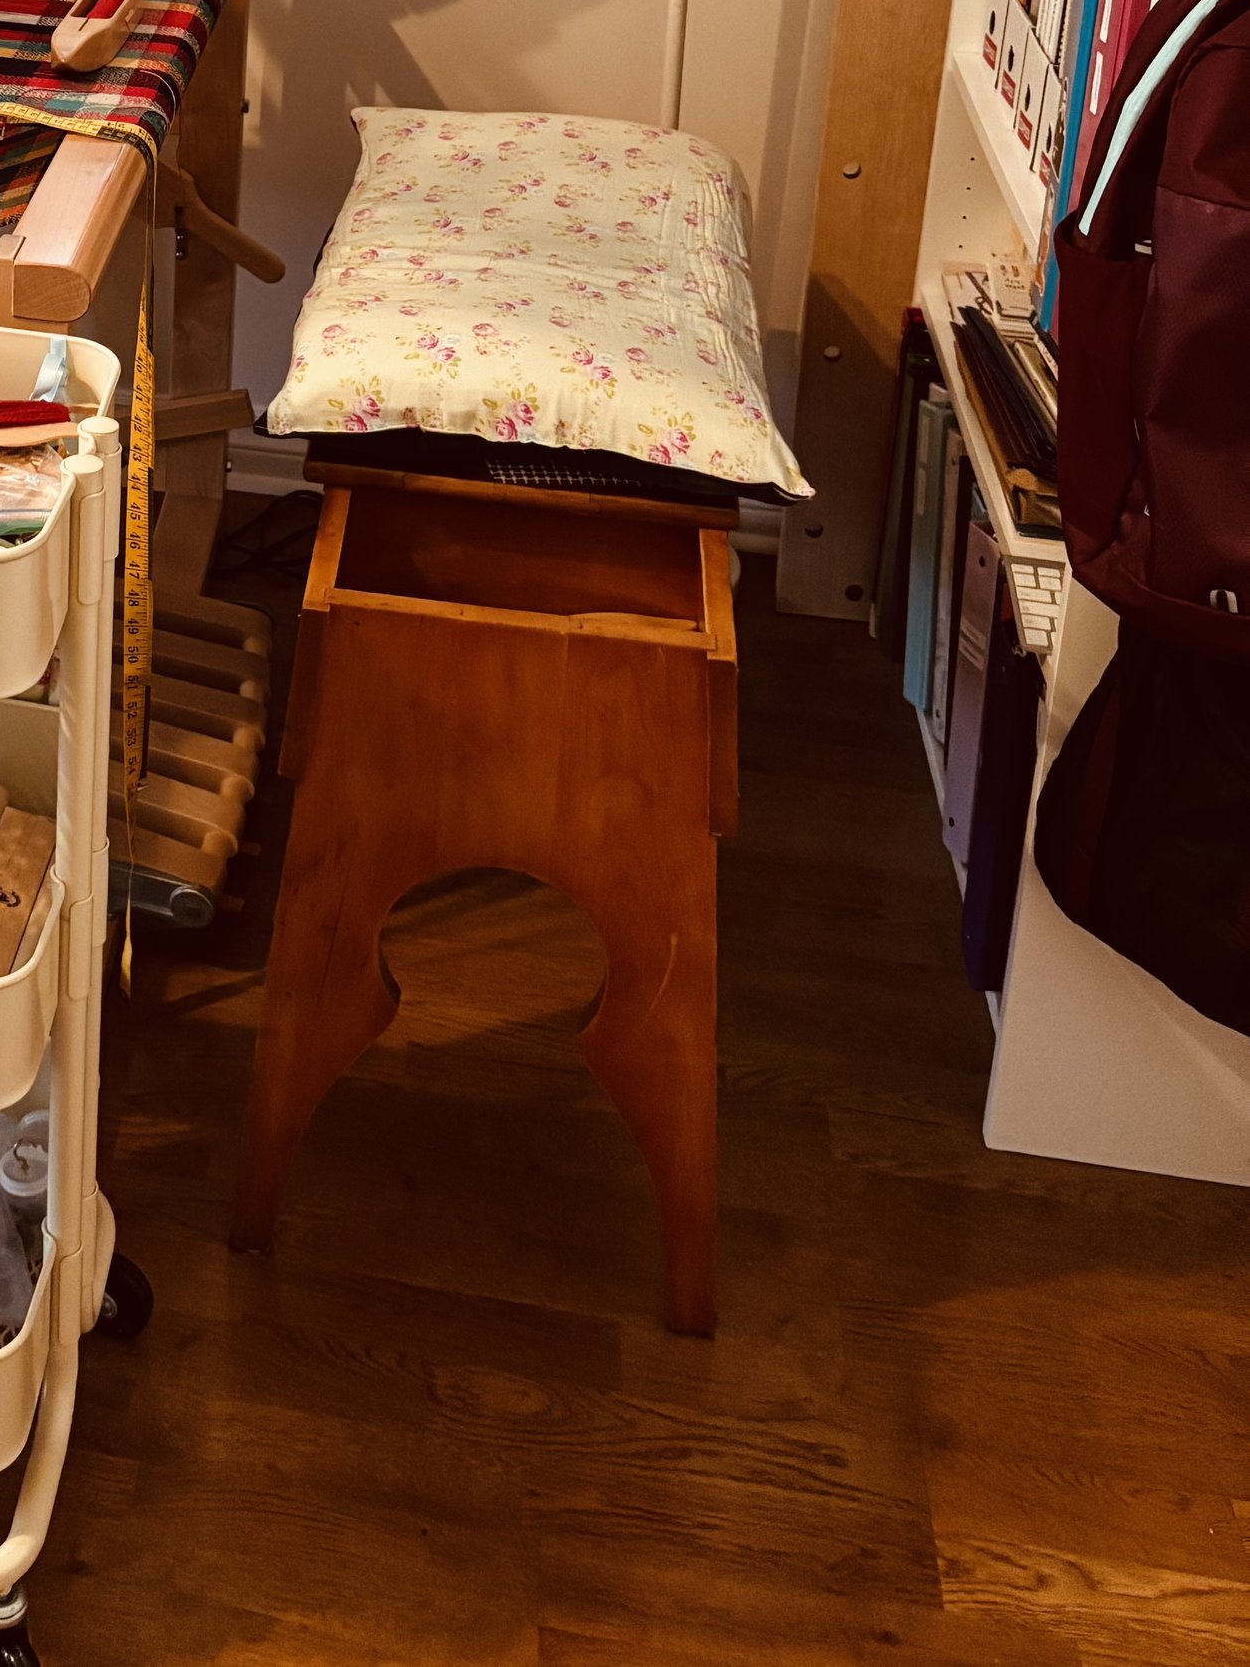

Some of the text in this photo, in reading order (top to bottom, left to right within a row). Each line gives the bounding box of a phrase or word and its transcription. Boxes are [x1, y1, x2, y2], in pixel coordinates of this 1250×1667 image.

[132, 444, 143, 463] 43
[131, 472, 142, 492] 44
[130, 502, 141, 521] 45
[129, 531, 141, 550] 46
[128, 560, 140, 580] 47
[128, 589, 140, 607] 48
[127, 617, 140, 635] 49
[127, 645, 139, 663] 50
[127, 674, 139, 690] 51
[127, 701, 138, 719] 52
[126, 728, 137, 747] 53
[127, 756, 137, 775] 54
